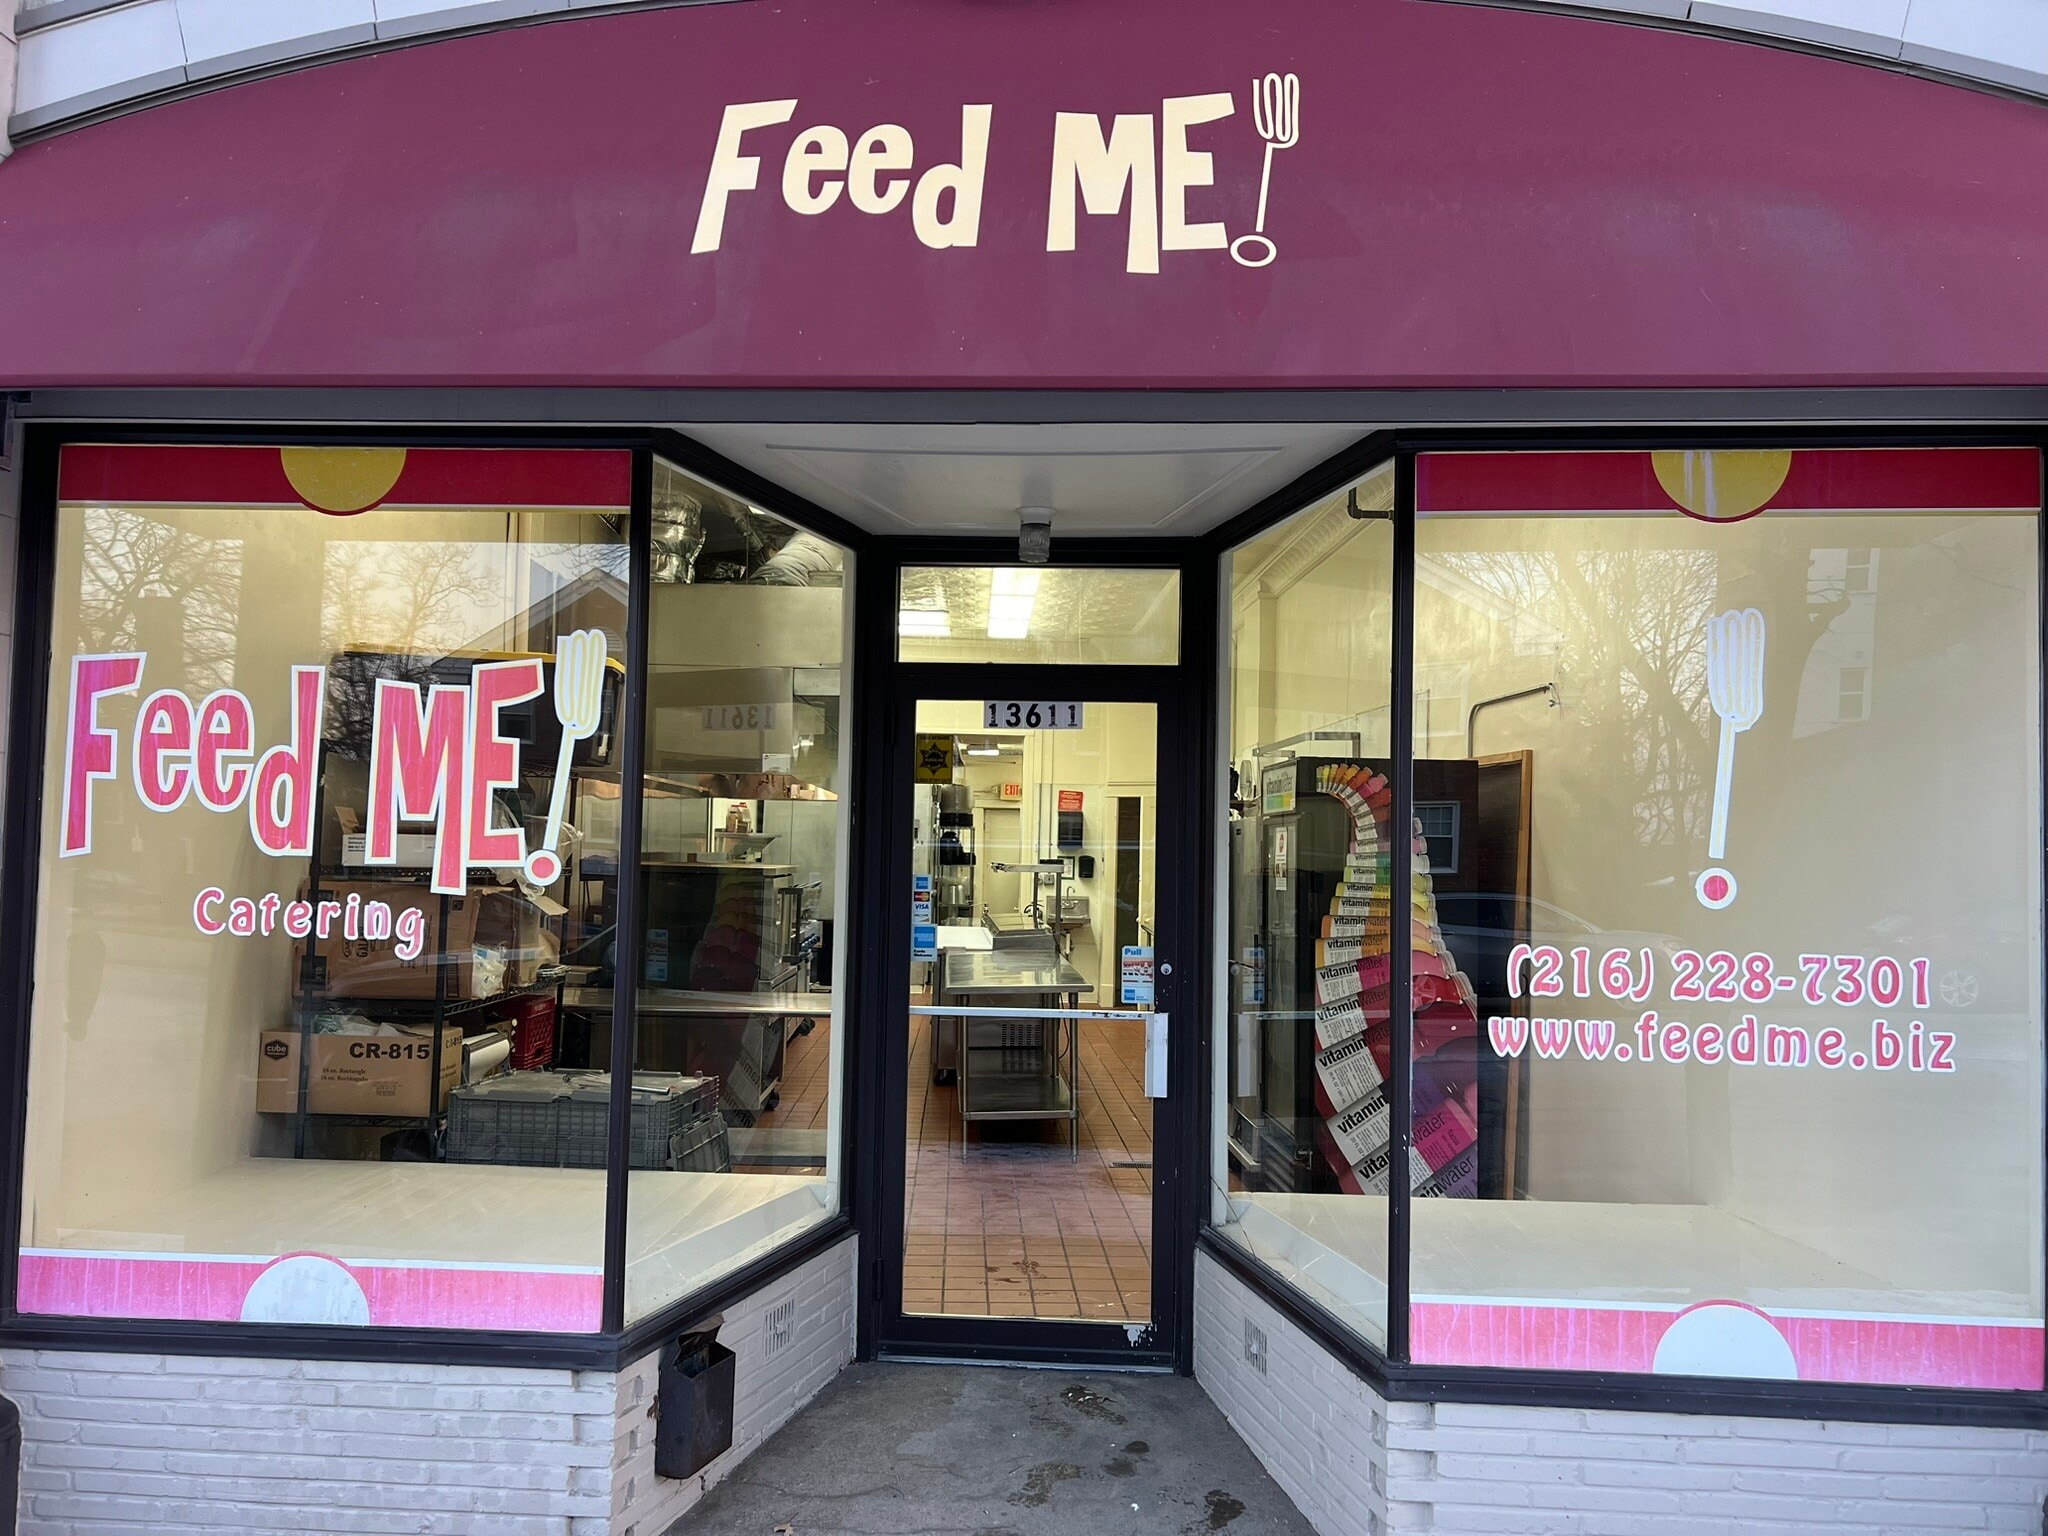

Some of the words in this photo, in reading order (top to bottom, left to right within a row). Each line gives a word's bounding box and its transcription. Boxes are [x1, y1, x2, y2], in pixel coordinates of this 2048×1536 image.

[690, 98, 993, 254] Feed
[988, 702, 1078, 728] 13611
[59, 651, 326, 858] Feed
[1004, 784, 1020, 796] EXIT
[193, 887, 425, 961] Catering
[1124, 948, 1142, 956] Pull
[1507, 943, 1655, 1002] (216)
[1670, 949, 1931, 1010] 228-7301
[350, 1042, 430, 1060] CR-815
[1487, 1011, 1957, 1073] www.feedme.biz
